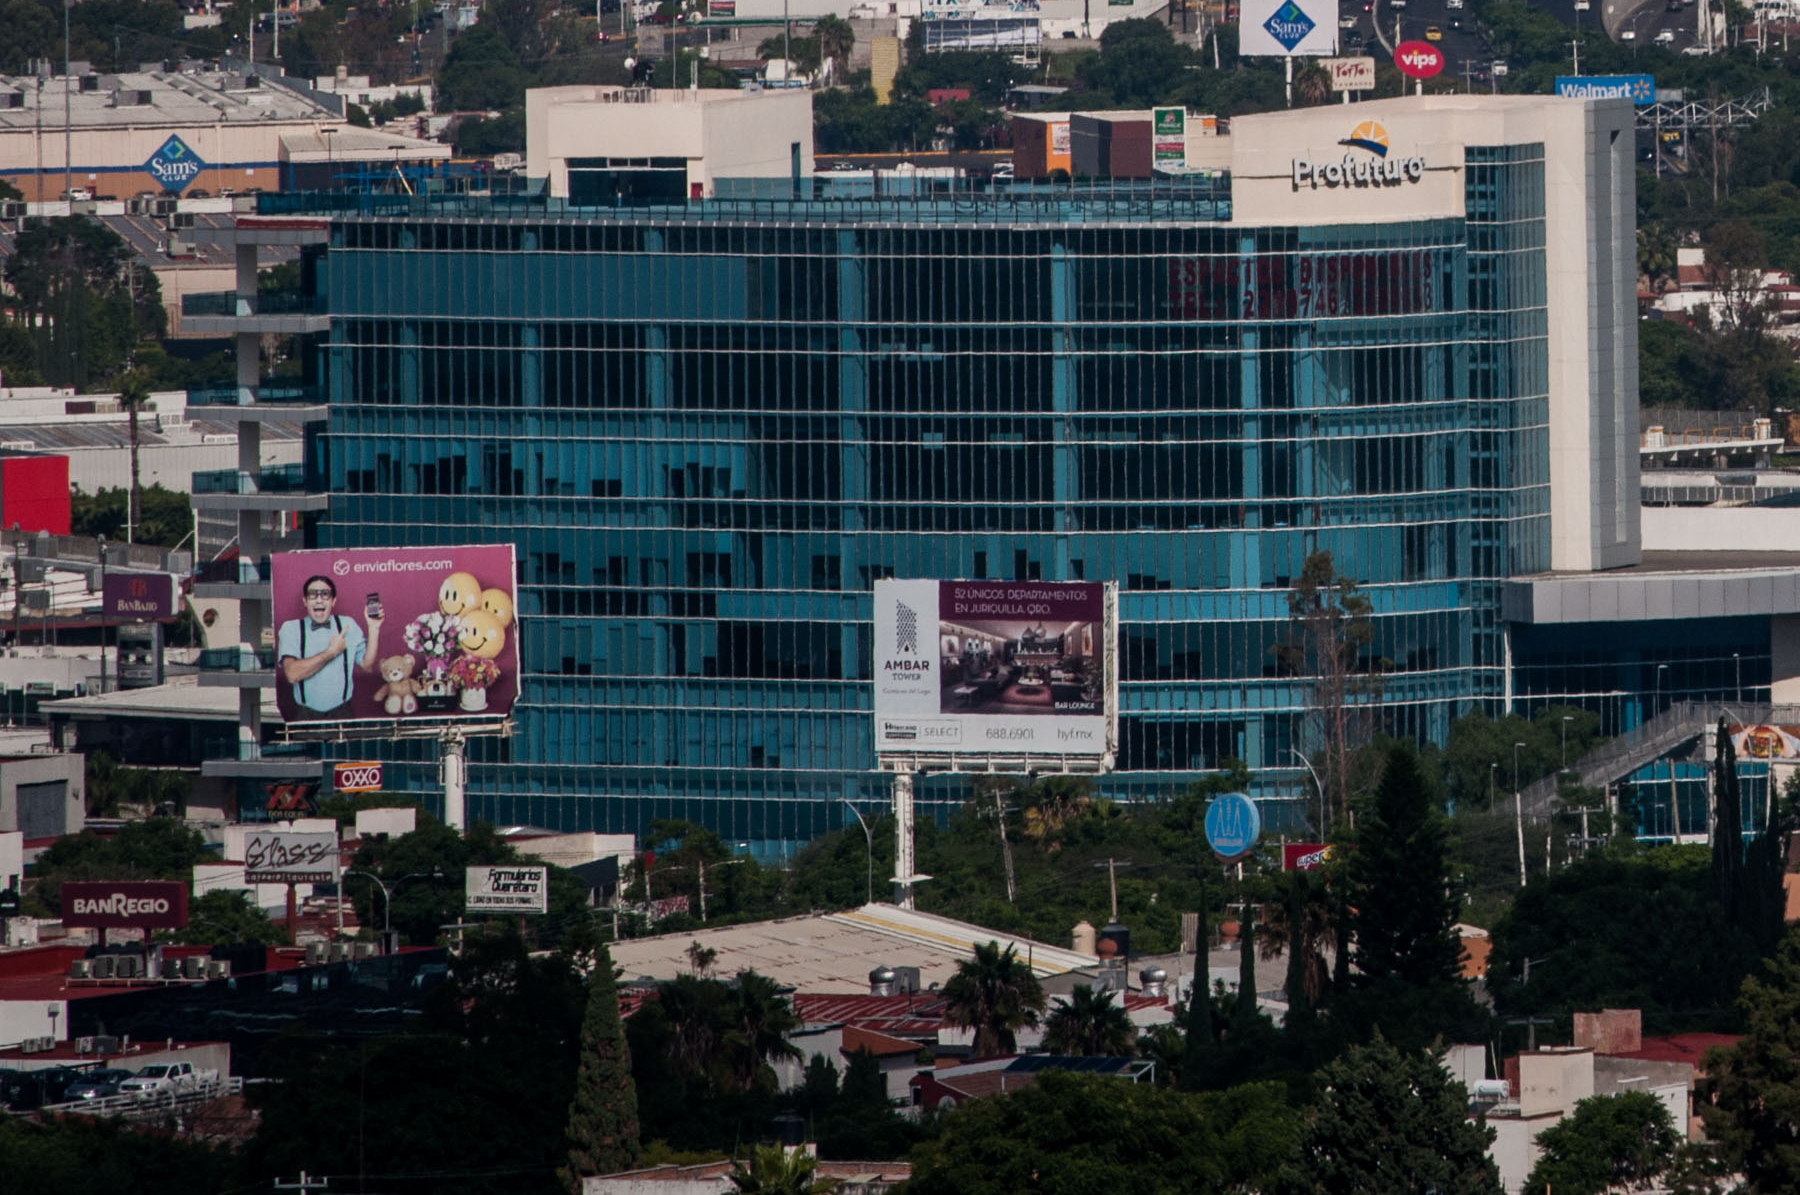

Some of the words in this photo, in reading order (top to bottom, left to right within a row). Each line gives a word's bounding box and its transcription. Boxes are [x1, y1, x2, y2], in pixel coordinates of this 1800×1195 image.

[1270, 18, 1308, 35] Sam's
[1402, 50, 1437, 69] vips
[1560, 82, 1631, 100] Walmart
[152, 157, 198, 176] Sam's
[1293, 154, 1423, 188] Profuturo
[354, 559, 453, 573] enviaflores.com
[967, 586, 1003, 599] ÚNICOS
[1008, 588, 1087, 601] DEPARTAMENTOS
[955, 603, 968, 613] EN
[884, 660, 929, 671] AMBAR
[892, 672, 921, 681] TOWER
[1069, 701, 1095, 710] LOUNGE
[923, 727, 959, 737] SELECT
[986, 727, 1034, 740] 688.6901
[1057, 727, 1093, 742] hyf.mx
[341, 767, 380, 789] OXXO
[245, 837, 333, 869] Glass
[488, 868, 542, 881] Formularios
